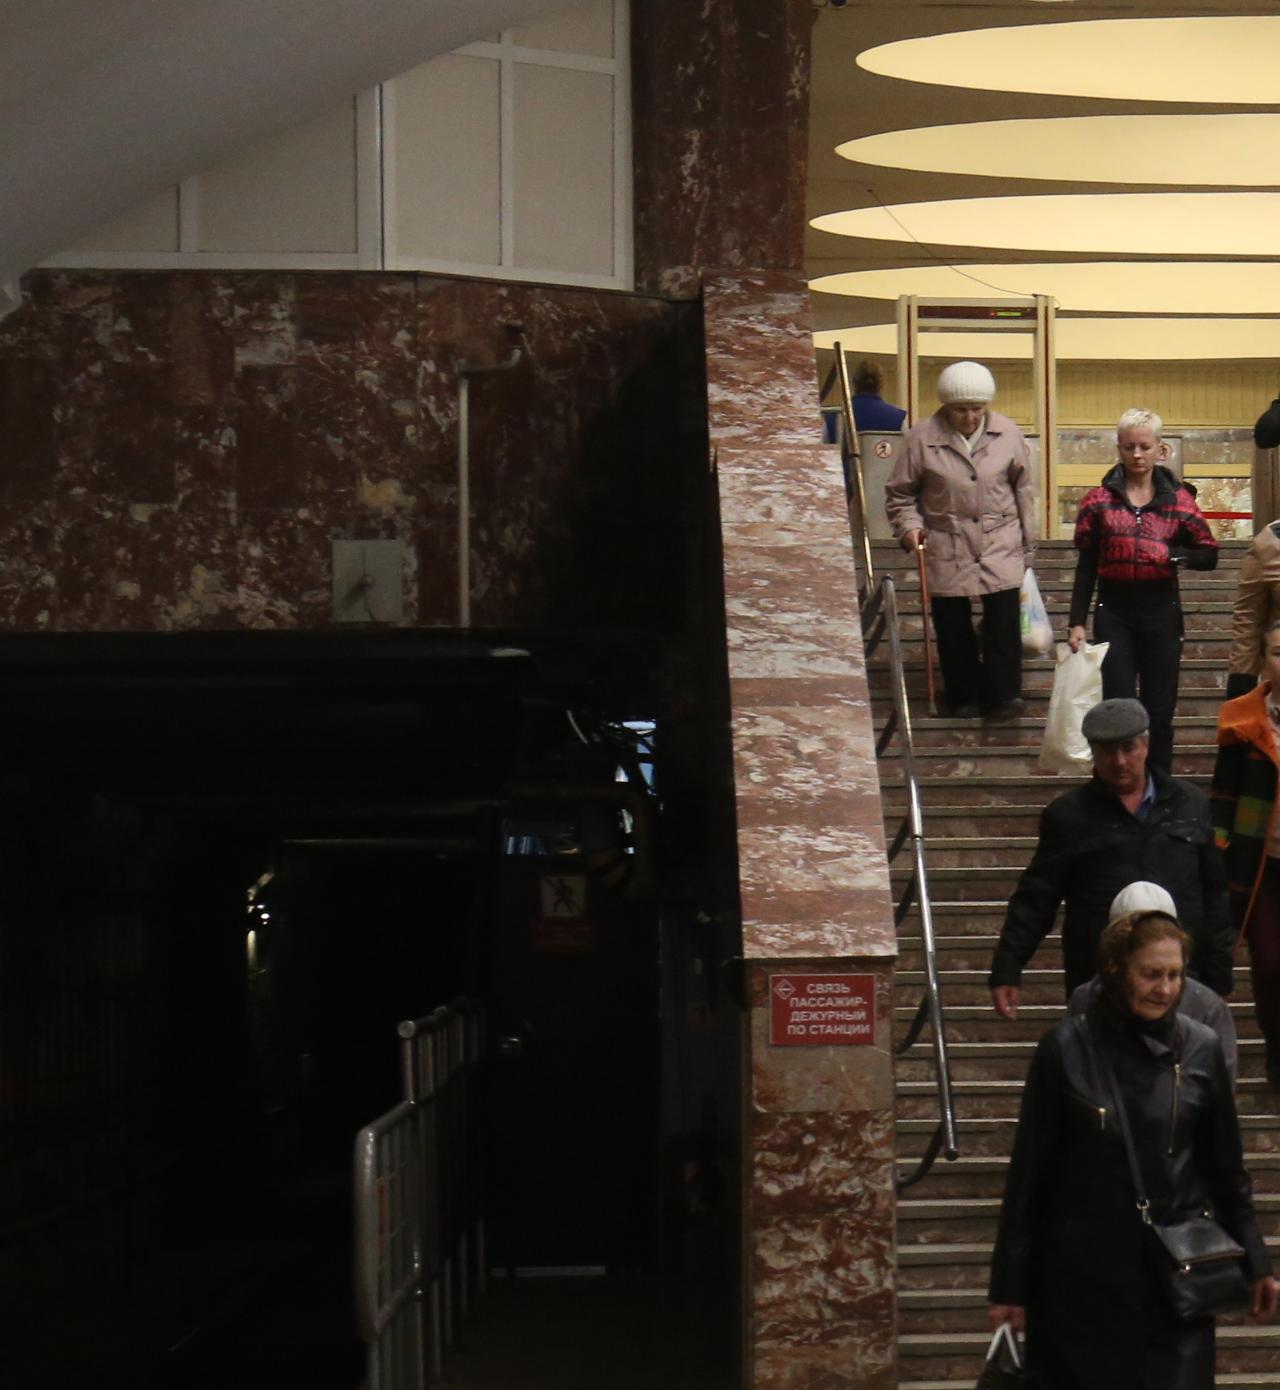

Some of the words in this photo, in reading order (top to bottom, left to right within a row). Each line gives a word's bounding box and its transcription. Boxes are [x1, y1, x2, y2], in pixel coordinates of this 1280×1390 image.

[806, 983, 851, 993] СВЯЗЬ
[789, 996, 868, 1008] ПАССАЖИР-
[790, 1009, 867, 1022] ДЕЖУРНЫЙ
[787, 1024, 806, 1035] ПО
[808, 1024, 871, 1036] СТАНЦИИ
